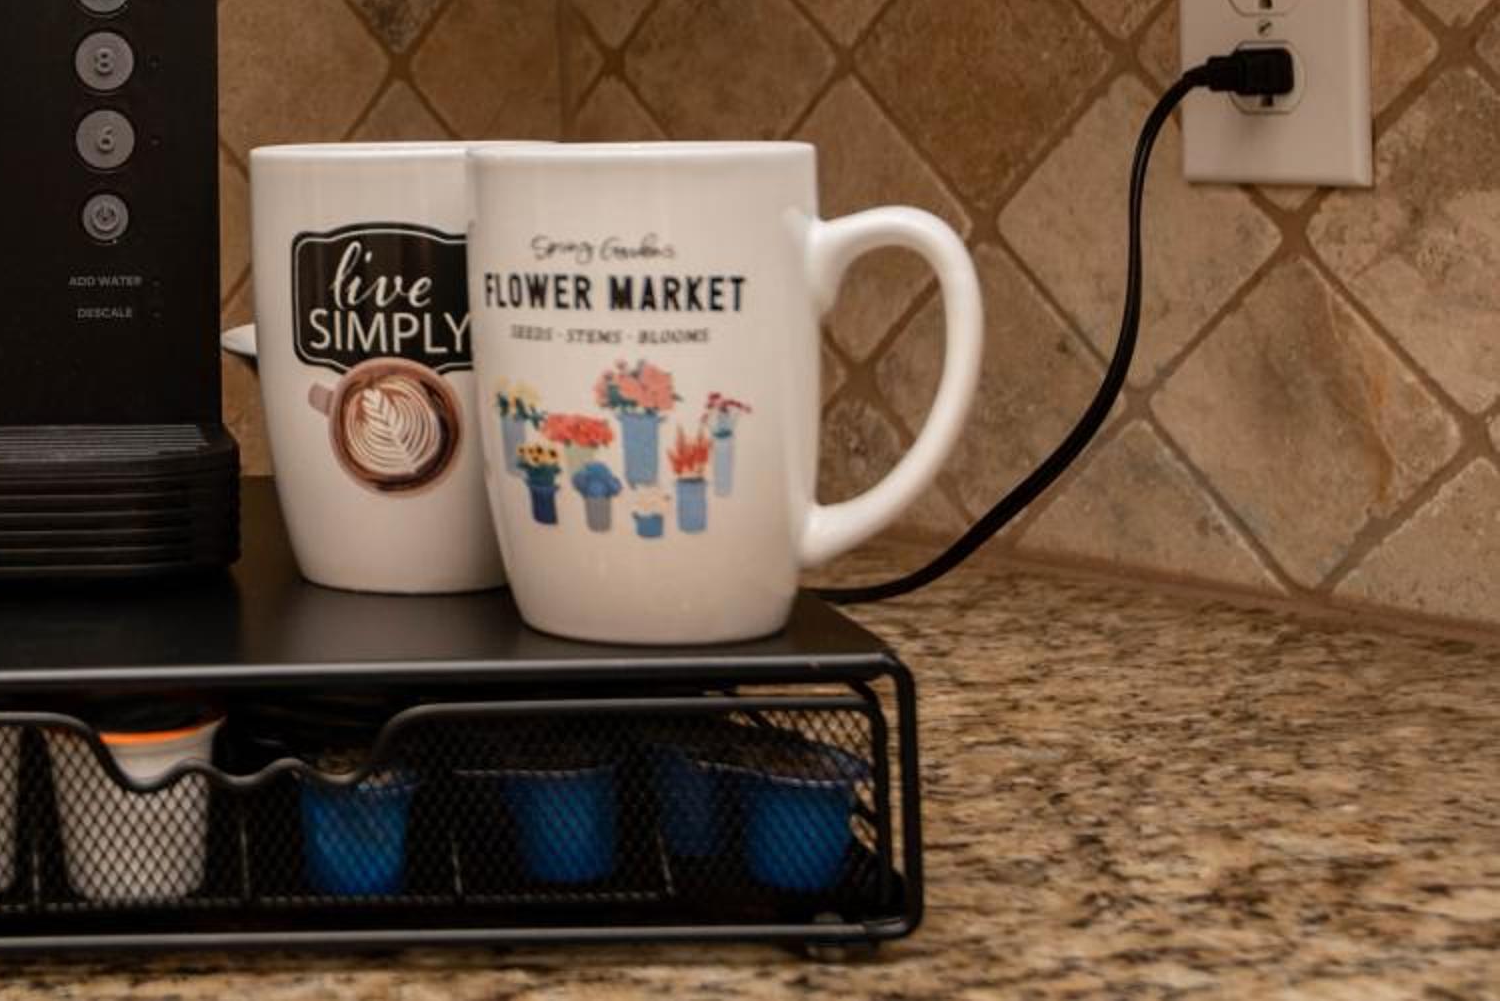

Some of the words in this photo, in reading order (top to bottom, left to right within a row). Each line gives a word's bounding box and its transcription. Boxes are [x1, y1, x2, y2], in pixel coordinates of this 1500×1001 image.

[96, 47, 114, 73] 8
[98, 125, 116, 151] 6
[68, 275, 96, 287] ADD
[98, 275, 143, 287] WATER
[331, 241, 432, 309] live
[484, 272, 593, 310] FLOWER
[608, 275, 747, 312] MARKET
[77, 307, 133, 319] DESCALE
[309, 308, 471, 354] SIMPLY
[511, 324, 554, 342] SEEDS
[566, 327, 622, 344] STEMS
[638, 327, 710, 345] BLOOMS
